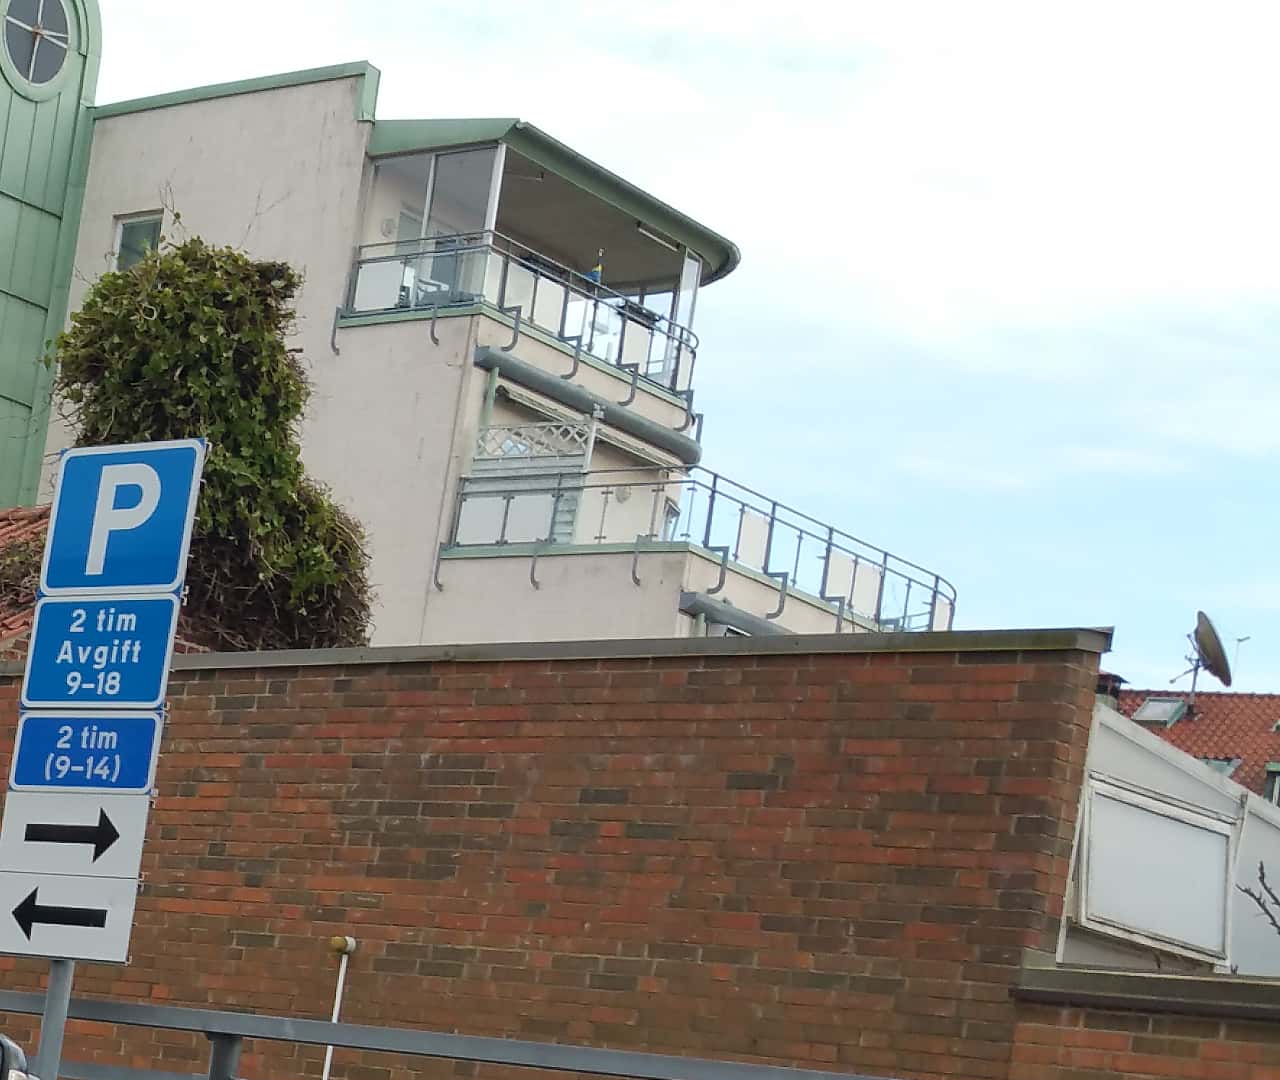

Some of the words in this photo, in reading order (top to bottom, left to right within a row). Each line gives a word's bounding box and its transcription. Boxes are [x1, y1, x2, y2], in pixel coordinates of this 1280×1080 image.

[84, 463, 162, 576] P
[69, 608, 87, 633] 2
[96, 607, 137, 632] tim
[55, 639, 142, 669] Avgift
[65, 671, 121, 695] 9-18
[56, 725, 73, 749] 2
[81, 725, 118, 749] tim
[44, 752, 121, 783] (9-14)
